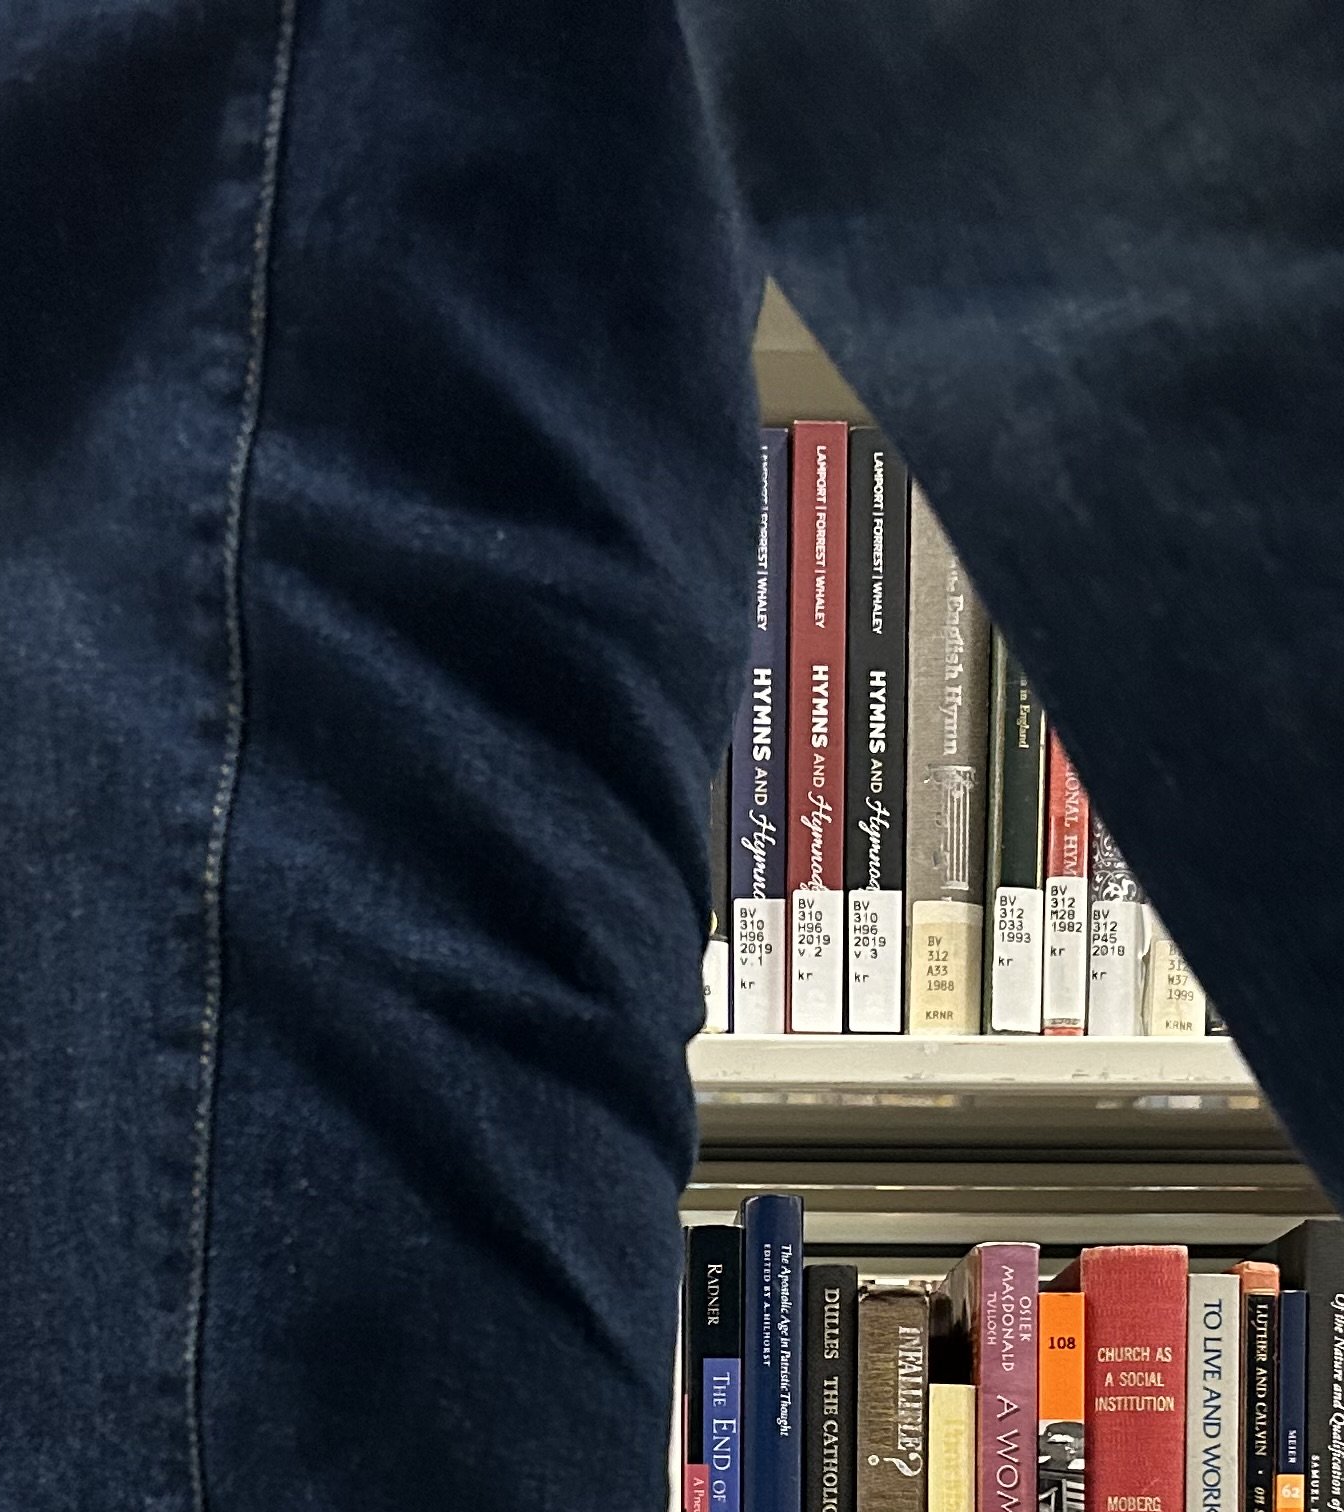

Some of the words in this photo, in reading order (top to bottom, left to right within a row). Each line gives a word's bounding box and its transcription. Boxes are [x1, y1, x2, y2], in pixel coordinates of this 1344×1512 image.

[817, 446, 826, 503] LAMPORT
[815, 513, 827, 567] FORREST
[814, 576, 825, 628] WHALEY
[944, 594, 965, 680] English
[753, 669, 771, 761] HYMNS
[811, 666, 828, 747] HYMNS
[869, 671, 886, 753] HYMNS
[939, 685, 962, 755] Hymn
[755, 767, 767, 805] AND
[812, 754, 825, 787] AND
[871, 759, 882, 793] AND
[799, 899, 814, 909] BV
[799, 911, 822, 921] 310
[1000, 896, 1016, 906] BV
[1000, 908, 1024, 919] 312
[798, 934, 830, 945] 2019
[799, 923, 822, 933] H96
[999, 920, 1023, 931] D33
[1002, 932, 1031, 943] 1993
[799, 970, 812, 980] kr
[708, 1264, 722, 1325] RADNER
[824, 1288, 839, 1359] DULLES
[1002, 1266, 1014, 1371] MACDONALD
[1019, 1296, 1031, 1341] OSIEK
[1204, 1299, 1222, 1330] TO
[1049, 1337, 1076, 1349] 108
[1256, 1305, 1268, 1361] LUTHER
[1098, 1347, 1150, 1363] CHURCH
[1156, 1347, 1172, 1363] AS
[1203, 1337, 1222, 1380] LIVE
[713, 1372, 730, 1406] THE
[1105, 1372, 1114, 1386] A
[1119, 1371, 1164, 1386] SOCIAL
[1256, 1367, 1267, 1398] AND
[824, 1377, 838, 1415] THE
[997, 1395, 1020, 1421] A
[1094, 1396, 1174, 1411] INSTITUTION
[1203, 1386, 1221, 1438] AND
[713, 1419, 736, 1470] END
[1255, 1402, 1267, 1455] CALVIN
[713, 1479, 726, 1502] OF
[1311, 1455, 1320, 1503] SAMUEL
[1108, 1496, 1162, 1512] MOBERG
